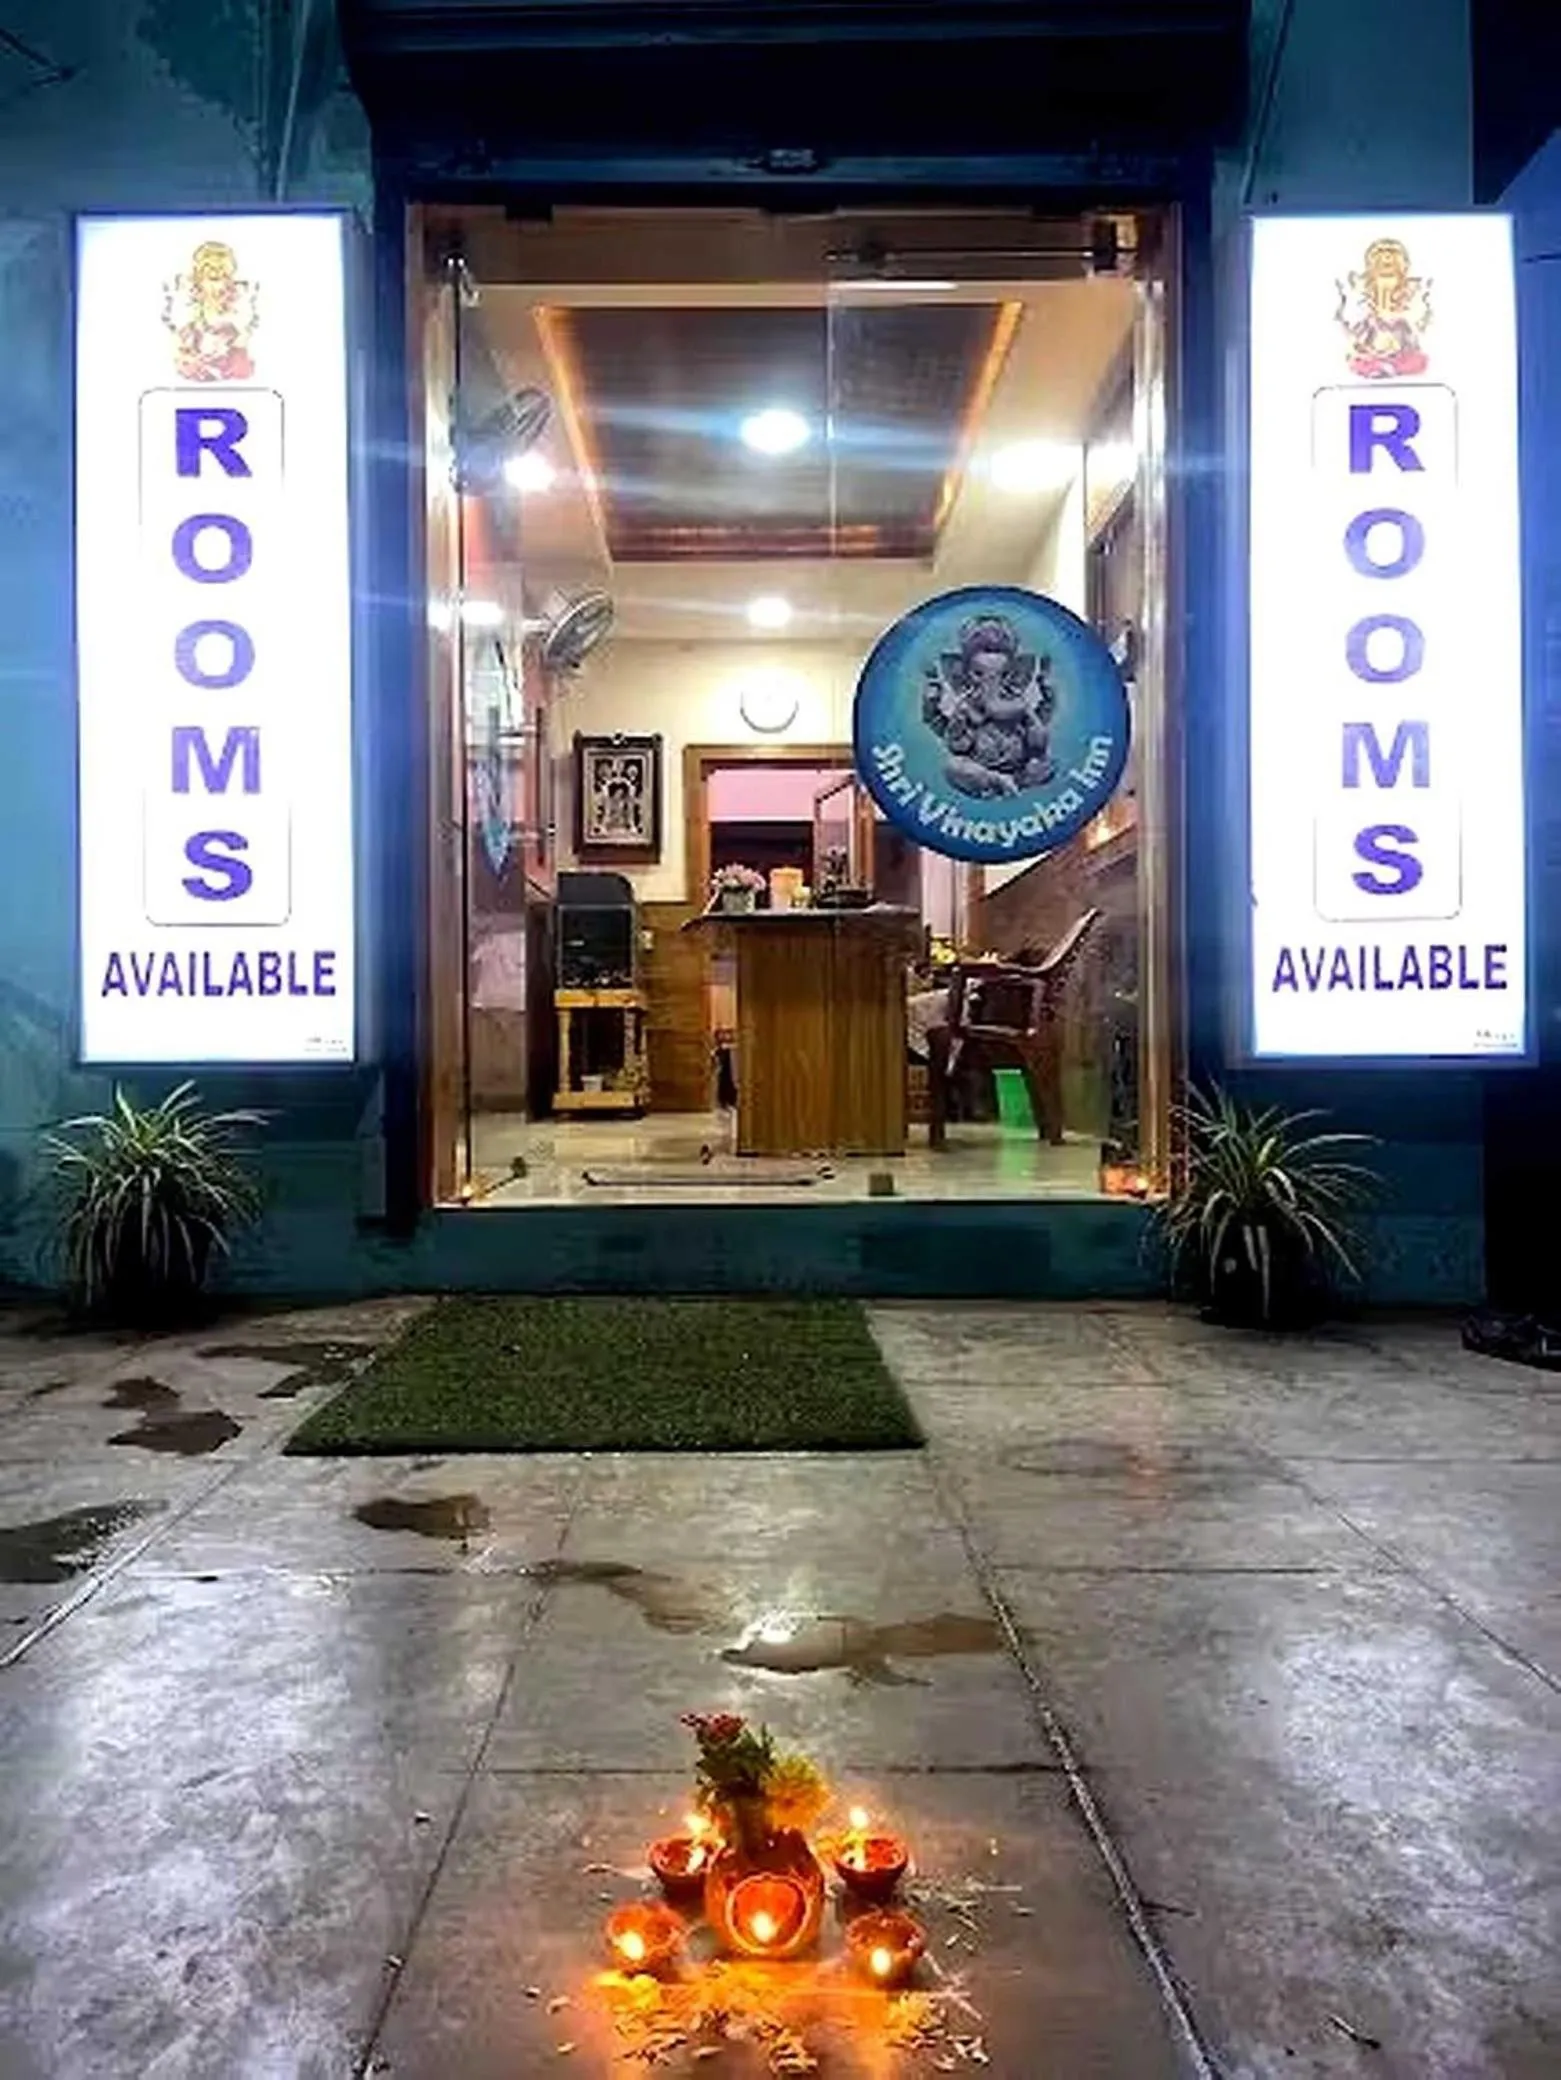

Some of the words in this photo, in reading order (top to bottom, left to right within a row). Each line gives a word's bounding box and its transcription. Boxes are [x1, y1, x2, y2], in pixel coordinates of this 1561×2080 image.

[171, 407, 260, 902] ROOMS
[1342, 404, 1431, 896] ROOMS
[873, 742, 927, 807] Shri
[917, 789, 1083, 847] Vinayaka
[1070, 735, 1113, 790] Inn
[101, 950, 336, 999] AVAILABLE
[1272, 944, 1507, 993] AVAILABLE
